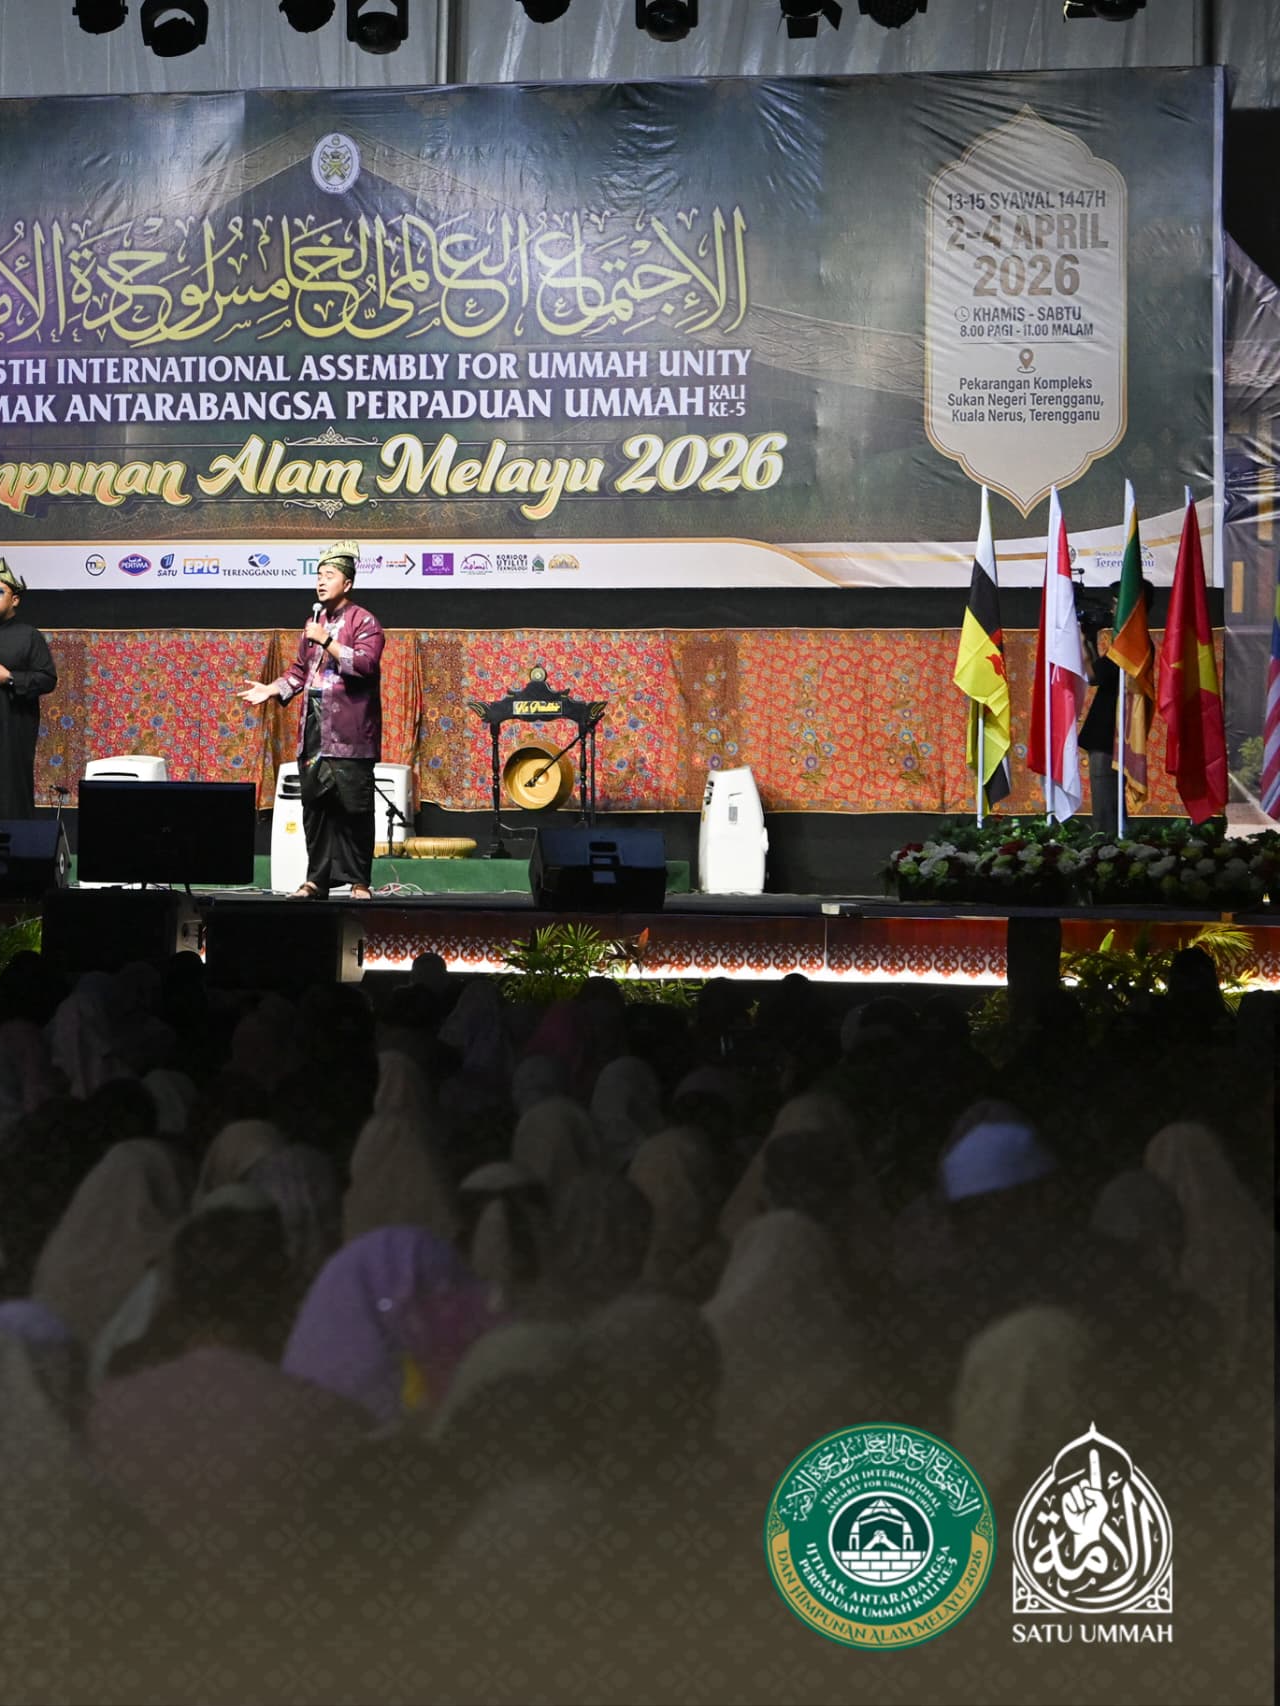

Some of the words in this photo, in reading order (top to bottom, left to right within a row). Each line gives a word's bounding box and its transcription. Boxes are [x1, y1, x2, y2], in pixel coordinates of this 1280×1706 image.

[946, 193, 986, 211] 13-15
[990, 191, 1055, 210] SYAWAL
[1058, 190, 1107, 208] 1447H
[945, 214, 1002, 250] 2-4
[1011, 213, 1109, 250] APRIL
[973, 253, 1080, 297] 2026
[973, 307, 1026, 322] KHAMIS
[1037, 306, 1082, 321] SABTU
[960, 325, 984, 337] 8.00
[987, 324, 1013, 337] PAGI
[1023, 324, 1048, 336] 11.00
[1052, 323, 1094, 336] MALAM
[57, 355, 291, 385] INTERNATIONAL
[298, 352, 450, 382] ASSEMBLY
[458, 351, 519, 380] FOR
[528, 350, 648, 379] UMMAH
[658, 348, 752, 377] UNITY
[708, 384, 745, 400] KALI
[959, 377, 1031, 393] Pekarangan
[1033, 376, 1093, 392] Kompleks
[65, 391, 336, 423] ANTARABANGSA
[346, 388, 552, 420] PERPADUAN
[565, 386, 705, 418] UMMAH
[947, 393, 984, 406] Sukan
[988, 392, 1027, 408] Negeri
[1029, 392, 1104, 408] Terengganu,
[708, 402, 746, 417] KE-5
[951, 409, 985, 423] Kuala
[988, 409, 1026, 423] Nerus,
[1029, 408, 1100, 424] Terengganu
[196, 433, 369, 504] Alam
[375, 432, 606, 521] Melayu
[615, 431, 790, 493] 2026
[496, 559, 528, 567] UTILITI
[157, 569, 178, 577] SATU
[222, 568, 278, 577] TERENGGANU
[280, 568, 297, 577] INC
